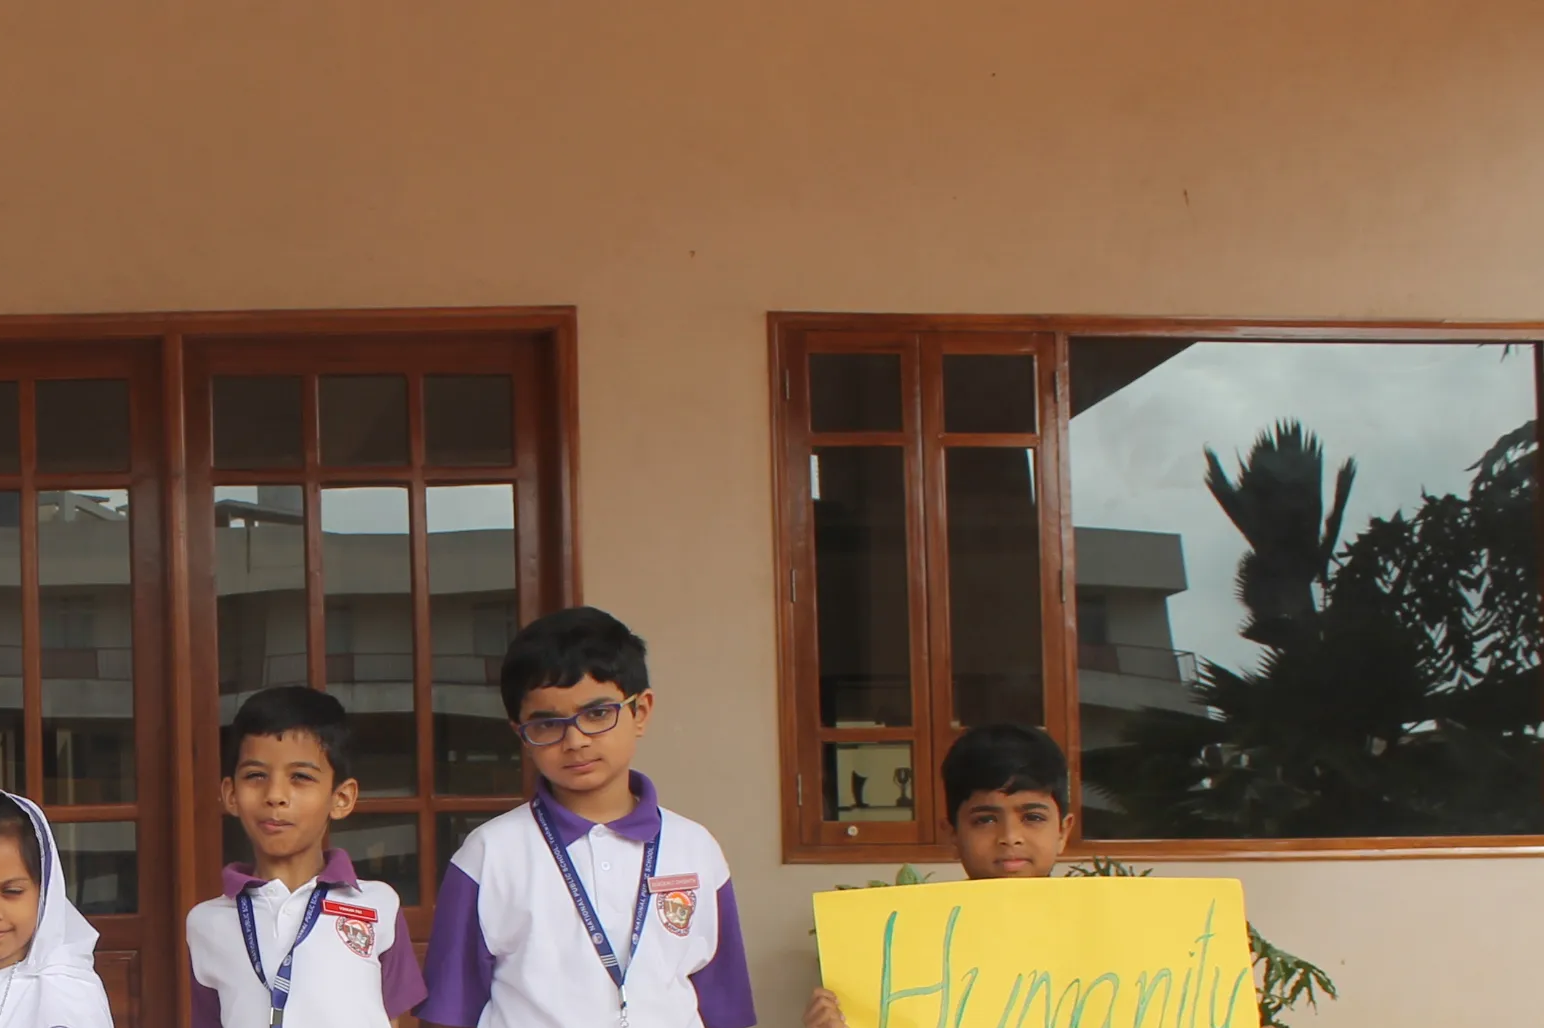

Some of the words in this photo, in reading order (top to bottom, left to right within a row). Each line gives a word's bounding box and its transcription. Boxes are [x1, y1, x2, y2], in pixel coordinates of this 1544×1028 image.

[565, 872, 580, 897] PUBLIC
[576, 897, 596, 932] NATIONAL
[635, 898, 646, 931] NATIONAL
